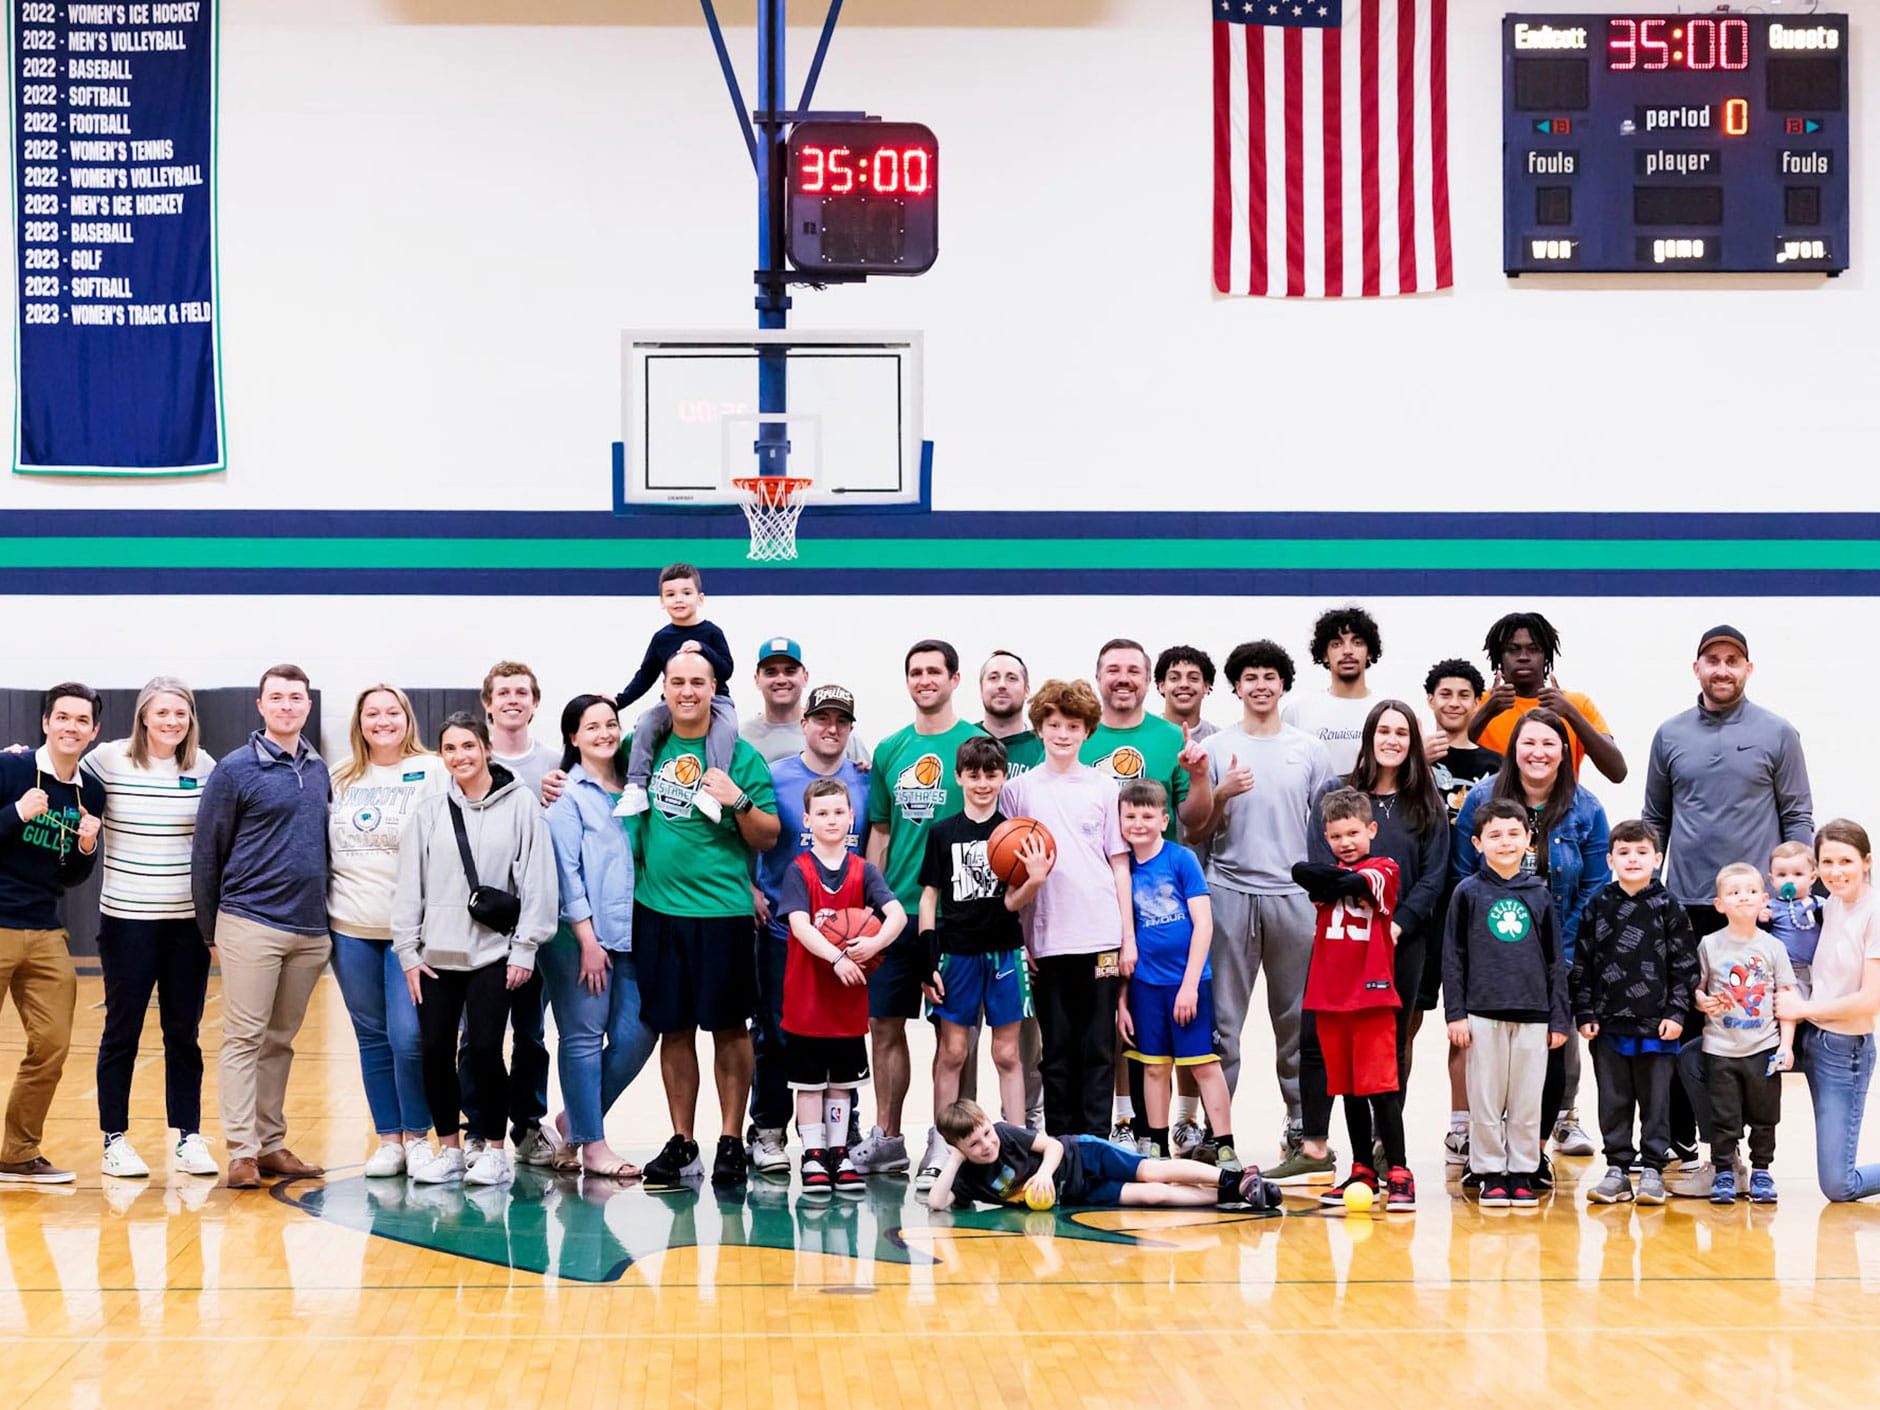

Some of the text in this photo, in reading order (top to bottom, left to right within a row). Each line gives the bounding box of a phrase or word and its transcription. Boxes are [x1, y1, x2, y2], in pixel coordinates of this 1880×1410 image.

[22, 2, 56, 22] 2022
[67, 4, 126, 24] WOMEN'S
[128, 3, 150, 24] ICE
[152, 1, 200, 23] HOCKEY
[22, 29, 56, 49] 2022
[68, 31, 108, 51] MEN'S
[110, 29, 187, 51] VOLLEYBALL
[1609, 19, 1748, 70] 35:00
[22, 57, 57, 77] 2022
[68, 58, 133, 79] BASEBALL
[23, 84, 57, 104] 2022
[68, 85, 131, 106] SOFTBALL
[23, 111, 58, 132] 2022
[69, 113, 132, 134] FOOTBALL
[1646, 98, 1748, 135] period 0
[24, 139, 59, 159] 2022
[69, 140, 128, 161] WOMEN'S
[129, 139, 174, 160] TENNIS
[802, 148, 928, 192] 35:00
[1528, 151, 1574, 173] fouls
[1646, 149, 1710, 175] player
[1782, 151, 1828, 173] fouls
[24, 166, 59, 187] 2022
[69, 167, 128, 188] WOMEN'S
[130, 164, 204, 188] VOLLEYBALL
[24, 193, 59, 214] 2023
[70, 194, 110, 215] MEN'S
[112, 195, 134, 215] ICE
[135, 193, 184, 215] HOCKEY
[24, 220, 59, 241] 2023
[70, 222, 134, 243] BASEBALL
[24, 248, 60, 269] 2023
[71, 249, 103, 270] GOLF
[24, 275, 60, 296] 2023
[71, 276, 133, 298] SOFTBALL
[25, 303, 60, 324] 2023
[70, 304, 125, 325] WOMEN'S
[127, 304, 167, 325] TRACK
[168, 303, 180, 323] &
[180, 302, 211, 322] FIELD
[22, 825, 73, 854] GULLS
[1490, 901, 1528, 920] CELTICS
